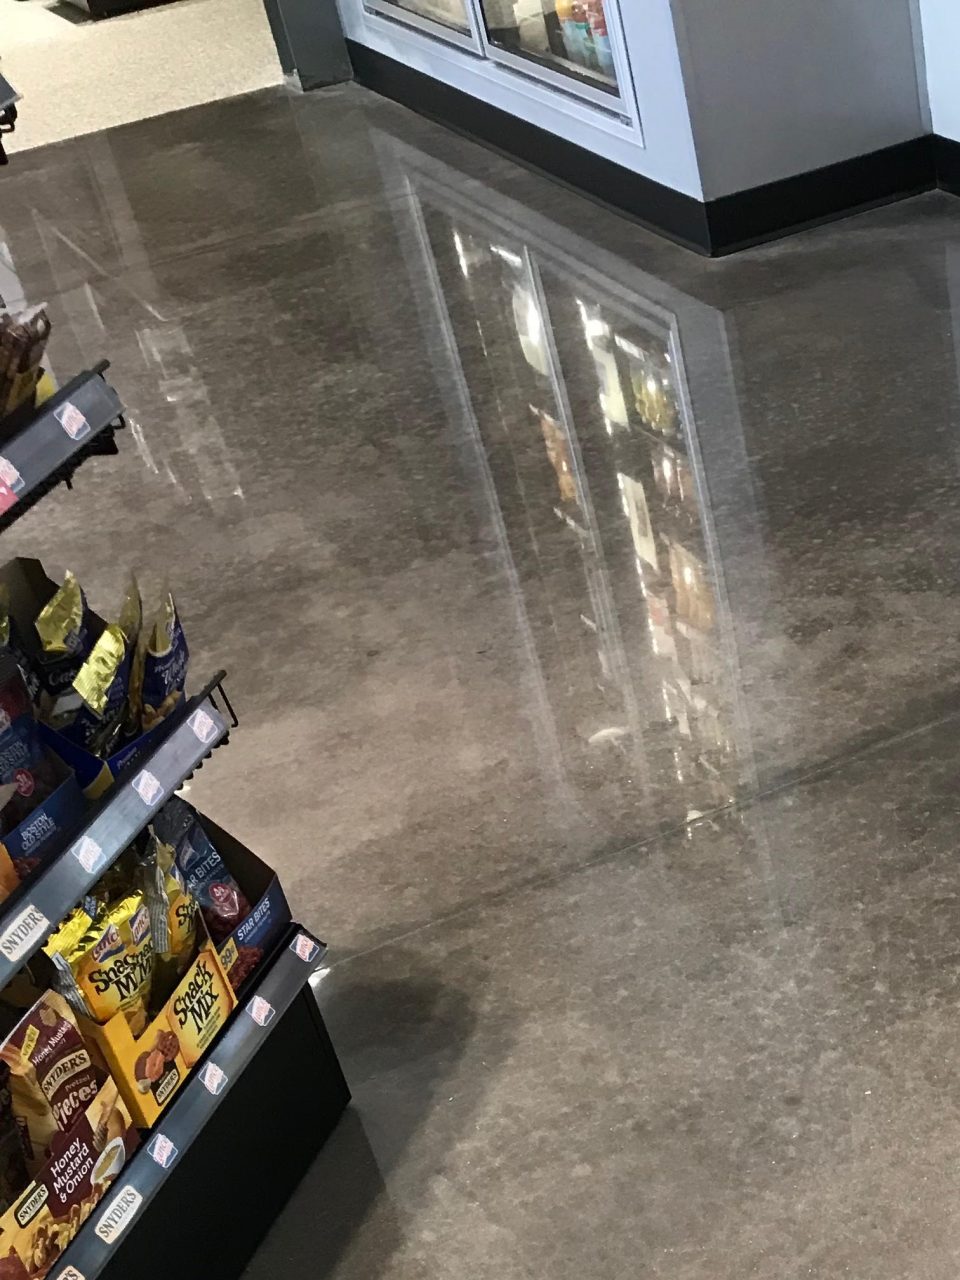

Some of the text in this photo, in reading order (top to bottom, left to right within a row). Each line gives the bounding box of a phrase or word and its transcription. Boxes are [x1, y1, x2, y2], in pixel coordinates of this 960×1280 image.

[20, 812, 48, 841] BOSTON
[35, 816, 55, 839] STYLE
[195, 851, 221, 879] BITES
[237, 917, 255, 941] STAR
[253, 897, 270, 923] BITES
[173, 960, 214, 1030] Snack
[188, 982, 220, 1035] Mix
[43, 1052, 87, 1094] SNYDER'S
[52, 1080, 98, 1131] Pieces
[50, 1137, 81, 1178] Honey
[53, 1142, 90, 1195] Mustard
[59, 1157, 94, 1203] & Onion
[99, 1188, 137, 1238] SNYDER'S
